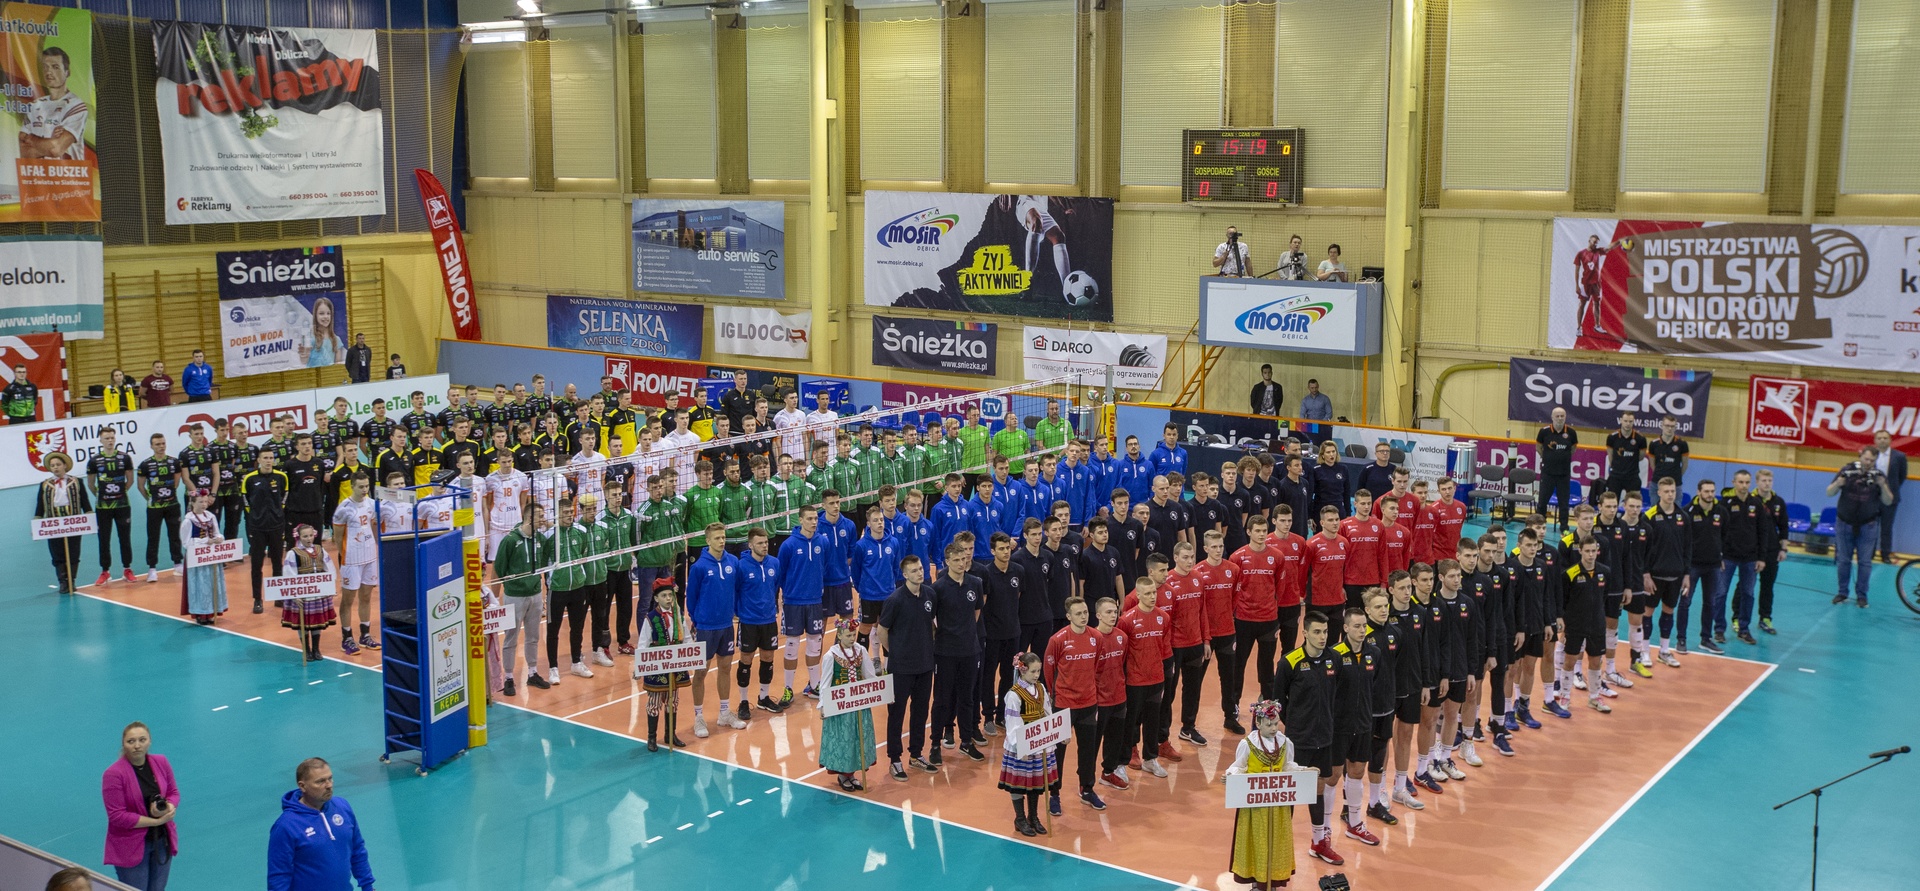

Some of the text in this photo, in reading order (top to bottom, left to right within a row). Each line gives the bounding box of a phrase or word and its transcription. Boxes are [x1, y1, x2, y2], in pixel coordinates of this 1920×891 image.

[246, 34, 272, 45] Nowe
[275, 49, 309, 61] Oblicze
[177, 55, 364, 115] reklamy
[312, 151, 330, 159] Litery
[48, 166, 89, 177] BUSZEK
[230, 164, 253, 172] odzieży
[292, 163, 319, 171] Systemy
[319, 161, 363, 170] wystawiennicze
[1194, 167, 1234, 176] GOSPODARZE
[191, 202, 232, 212] Reklamy
[1643, 236, 1801, 256] MISTRZOSTWA
[697, 248, 760, 263] auto serwis
[983, 248, 1004, 271] ŻYJ
[228, 256, 336, 285] Śnieżka
[877, 260, 924, 268] www.mosir.debica.pl
[0, 267, 65, 286] eldon.
[964, 272, 1023, 290] AKTYWNIE!
[1643, 256, 1800, 294] POLSKI
[291, 280, 336, 292] www.sniezka.pl
[570, 298, 678, 312] NATURALNA WODA MINERALNA
[1643, 293, 1800, 321] JUNIORÓW
[578, 308, 670, 343] SELENKA
[1656, 321, 1790, 343] DĘBICA 2019
[230, 329, 284, 348] DOBRA WODA
[584, 336, 667, 356] WIENIEC ZDRÓJ
[882, 322, 988, 359] Śnieżka
[243, 347, 250, 359] Z
[1051, 340, 1093, 354] DARCO
[940, 360, 988, 371] www.sniezka.pl
[1031, 362, 1158, 379] innowacje ogrzewania
[633, 371, 700, 397] ROMET
[1524, 367, 1693, 416] Śnieżka
[1754, 423, 1800, 437] ROMET
[106, 462, 116, 471] 11
[158, 466, 168, 476] 20
[503, 487, 512, 497] 18
[40, 516, 88, 529] AZS 2020
[359, 514, 368, 525] 12
[438, 510, 450, 522] 25
[38, 525, 92, 537] Częstochowa
[194, 542, 237, 557] EKS SKRA
[266, 573, 333, 588] JASTRZĘBSKI
[280, 585, 321, 598] WĘGIEL
[437, 599, 456, 614] KĘPA
[484, 607, 506, 621] UWM
[813, 619, 823, 631] 33
[640, 646, 701, 662] UMKS MOS
[637, 658, 704, 673] Wola Warszawa
[436, 669, 461, 687] Akademia
[830, 680, 886, 701] KS METRO
[836, 694, 883, 711] Warszawa
[1025, 715, 1063, 740] AKS V LO
[1029, 731, 1060, 750] Rzeszów
[1247, 775, 1297, 790] TREFL
[1246, 789, 1297, 805] GDAŃSK
